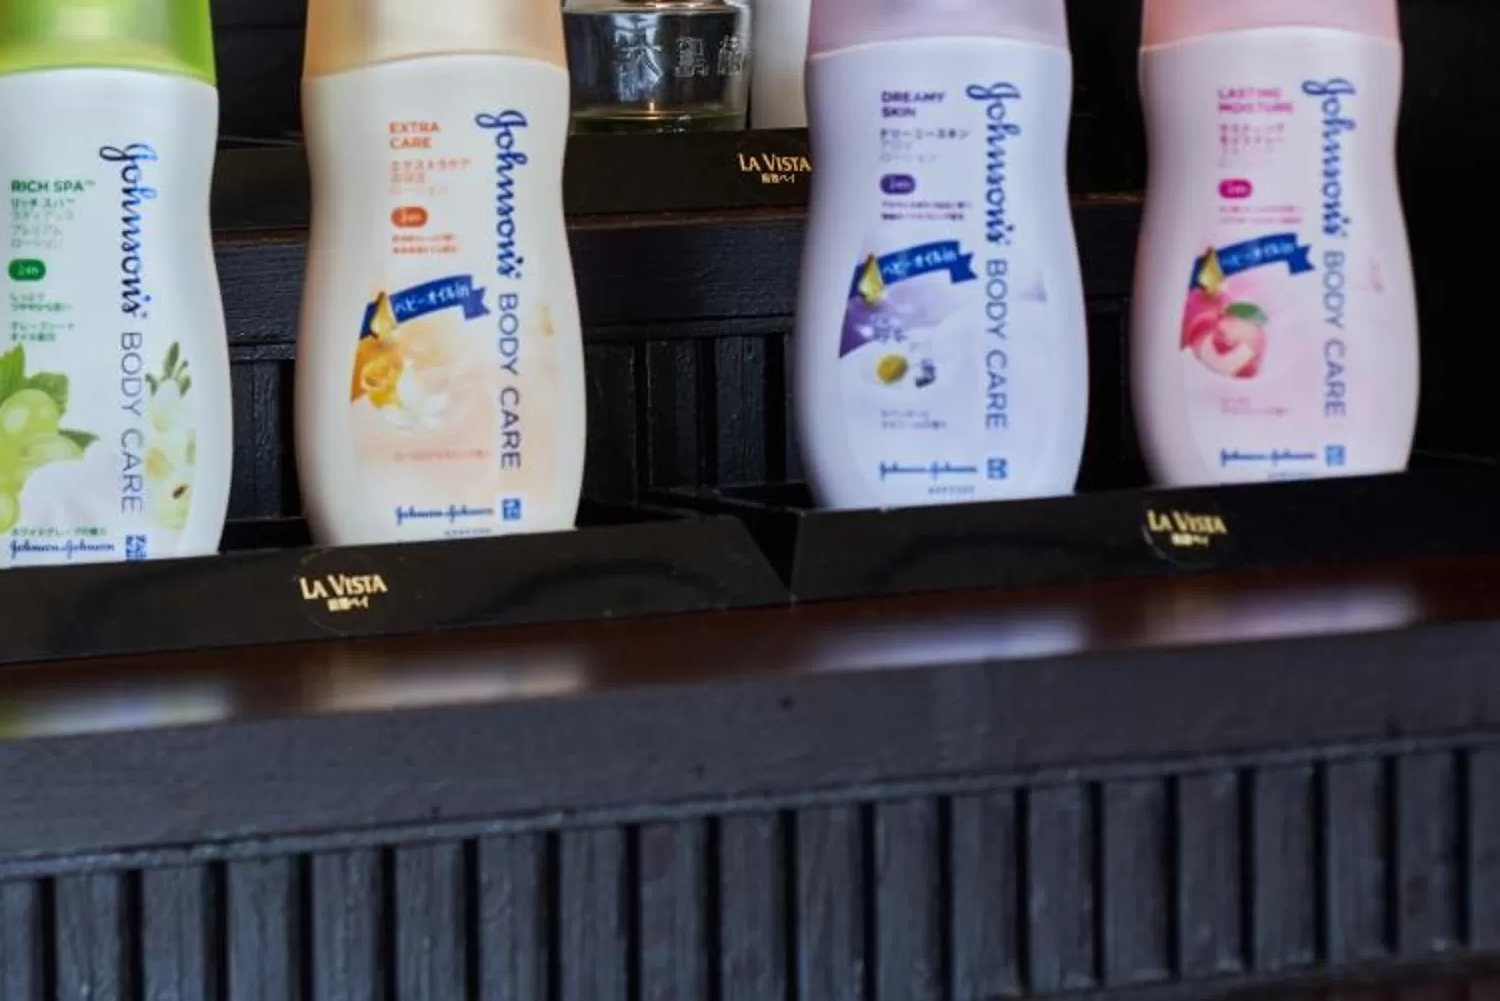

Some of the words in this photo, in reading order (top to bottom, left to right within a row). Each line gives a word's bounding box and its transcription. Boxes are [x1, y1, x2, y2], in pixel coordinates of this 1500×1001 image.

[11, 180, 49, 193] RICH
[737, 153, 760, 172] LA
[986, 259, 1008, 340] BODY
[1323, 250, 1345, 329] BODY
[121, 332, 143, 417] BODY
[499, 294, 519, 376] BODY
[985, 349, 1008, 430] CARE
[1323, 339, 1347, 418] CARE
[499, 387, 522, 470] CARE
[121, 428, 144, 515] CARE
[299, 576, 328, 600] LA
